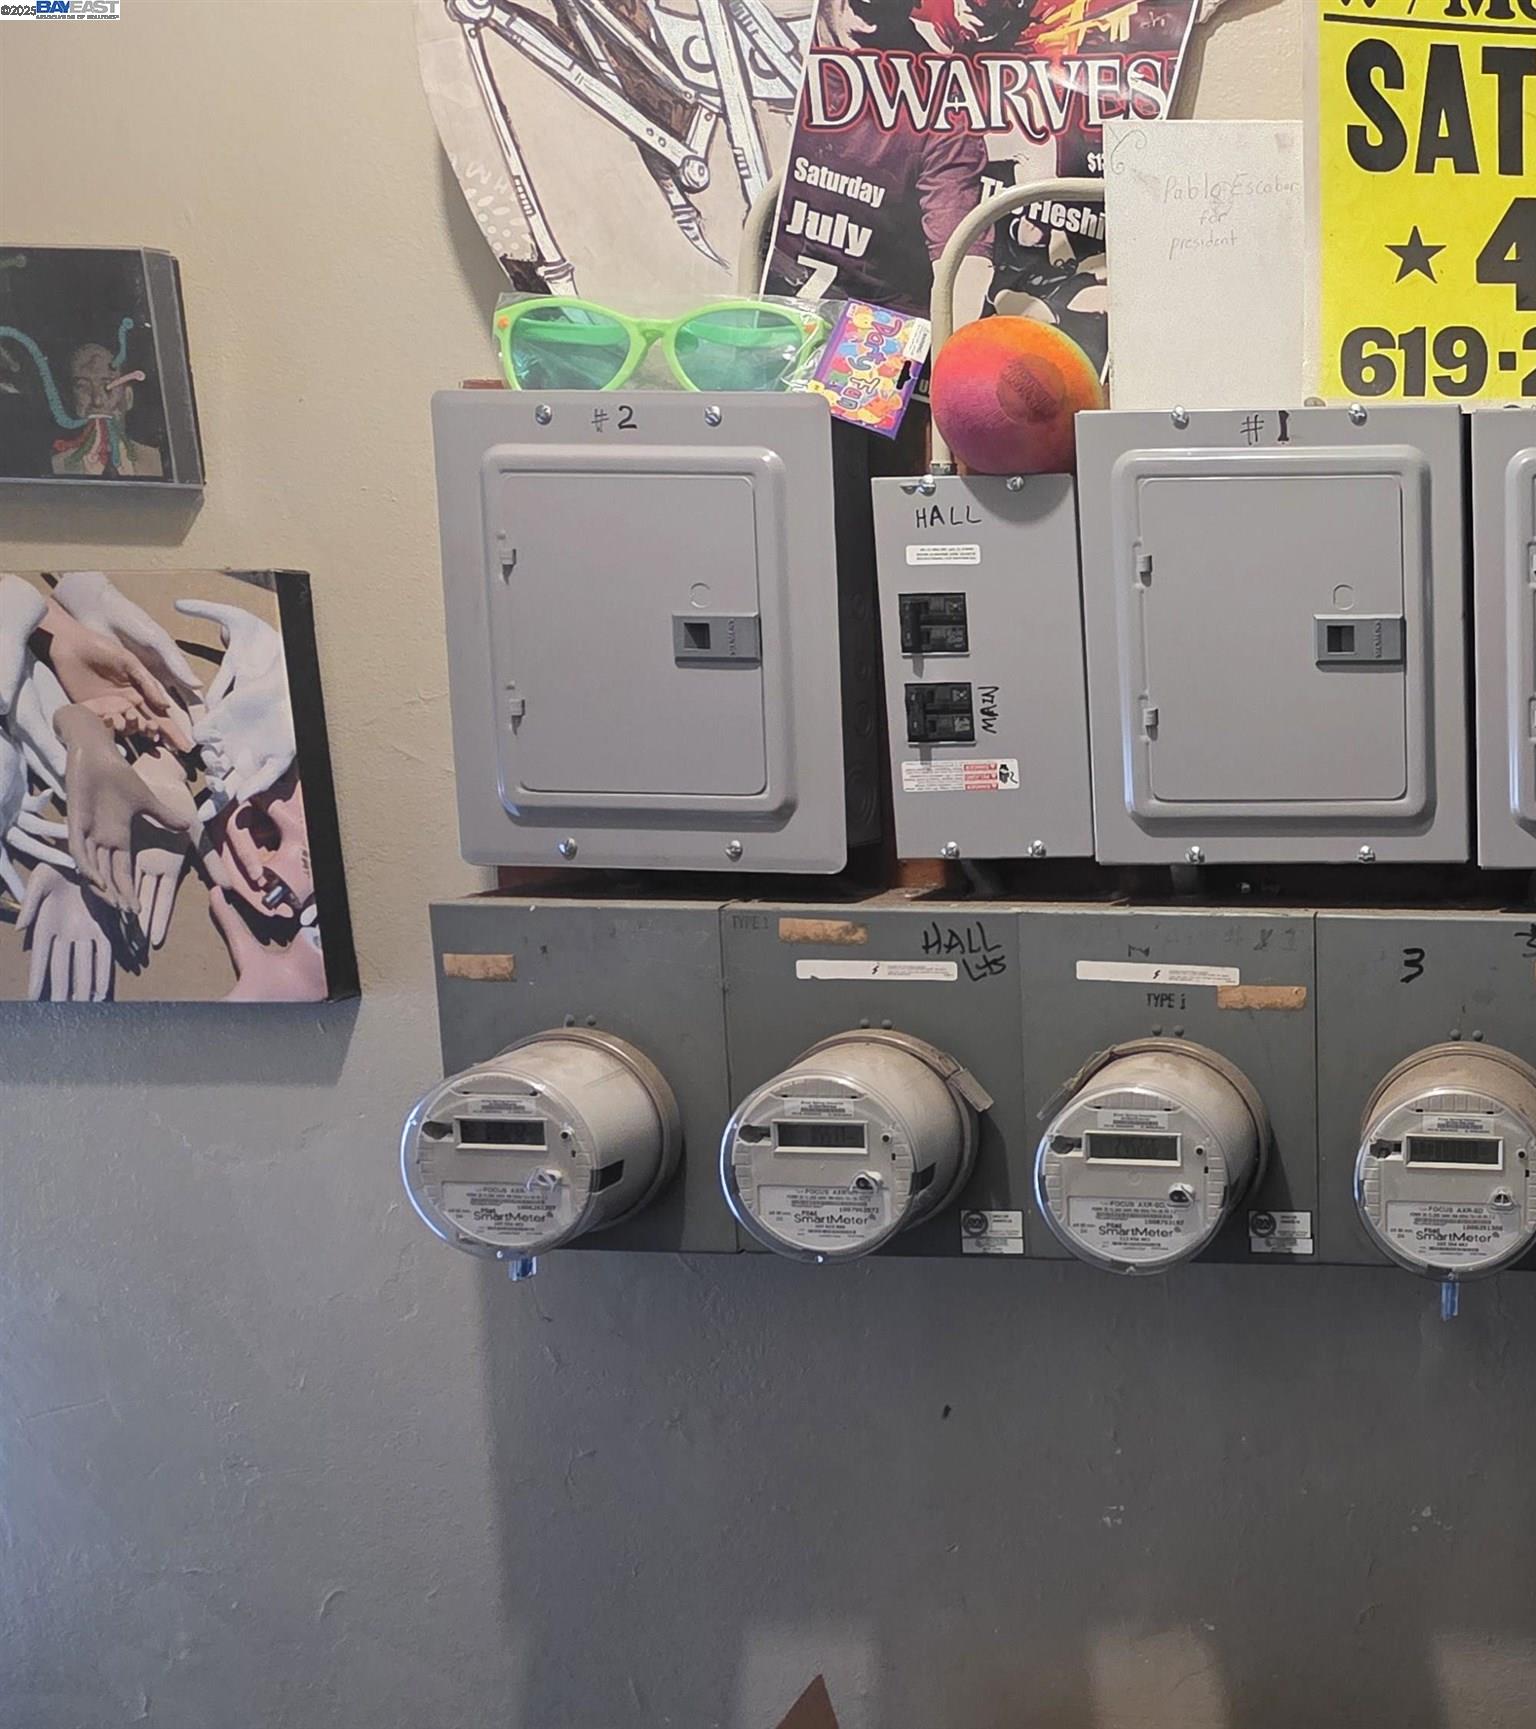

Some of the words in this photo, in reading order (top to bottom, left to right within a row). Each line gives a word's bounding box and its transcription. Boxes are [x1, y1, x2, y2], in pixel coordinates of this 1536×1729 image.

[806, 52, 1168, 137] DWARVES
[793, 156, 886, 208] Saturday
[1163, 172, 1224, 204] Pablo
[785, 200, 873, 257] July
[1199, 207, 1229, 225] for
[1168, 229, 1239, 261] president
[795, 255, 838, 299] 7
[847, 317, 904, 372] Party
[916, 504, 983, 528] HALL
[977, 686, 1000, 734] MAIN
[921, 921, 1002, 955] HALL
[1400, 947, 1426, 984] 3
[1147, 993, 1176, 1009] TYPE
[793, 1213, 868, 1225] SmartMeter
[1099, 1225, 1174, 1237] SmartMeter
[1416, 1231, 1492, 1243] SmartMeter
